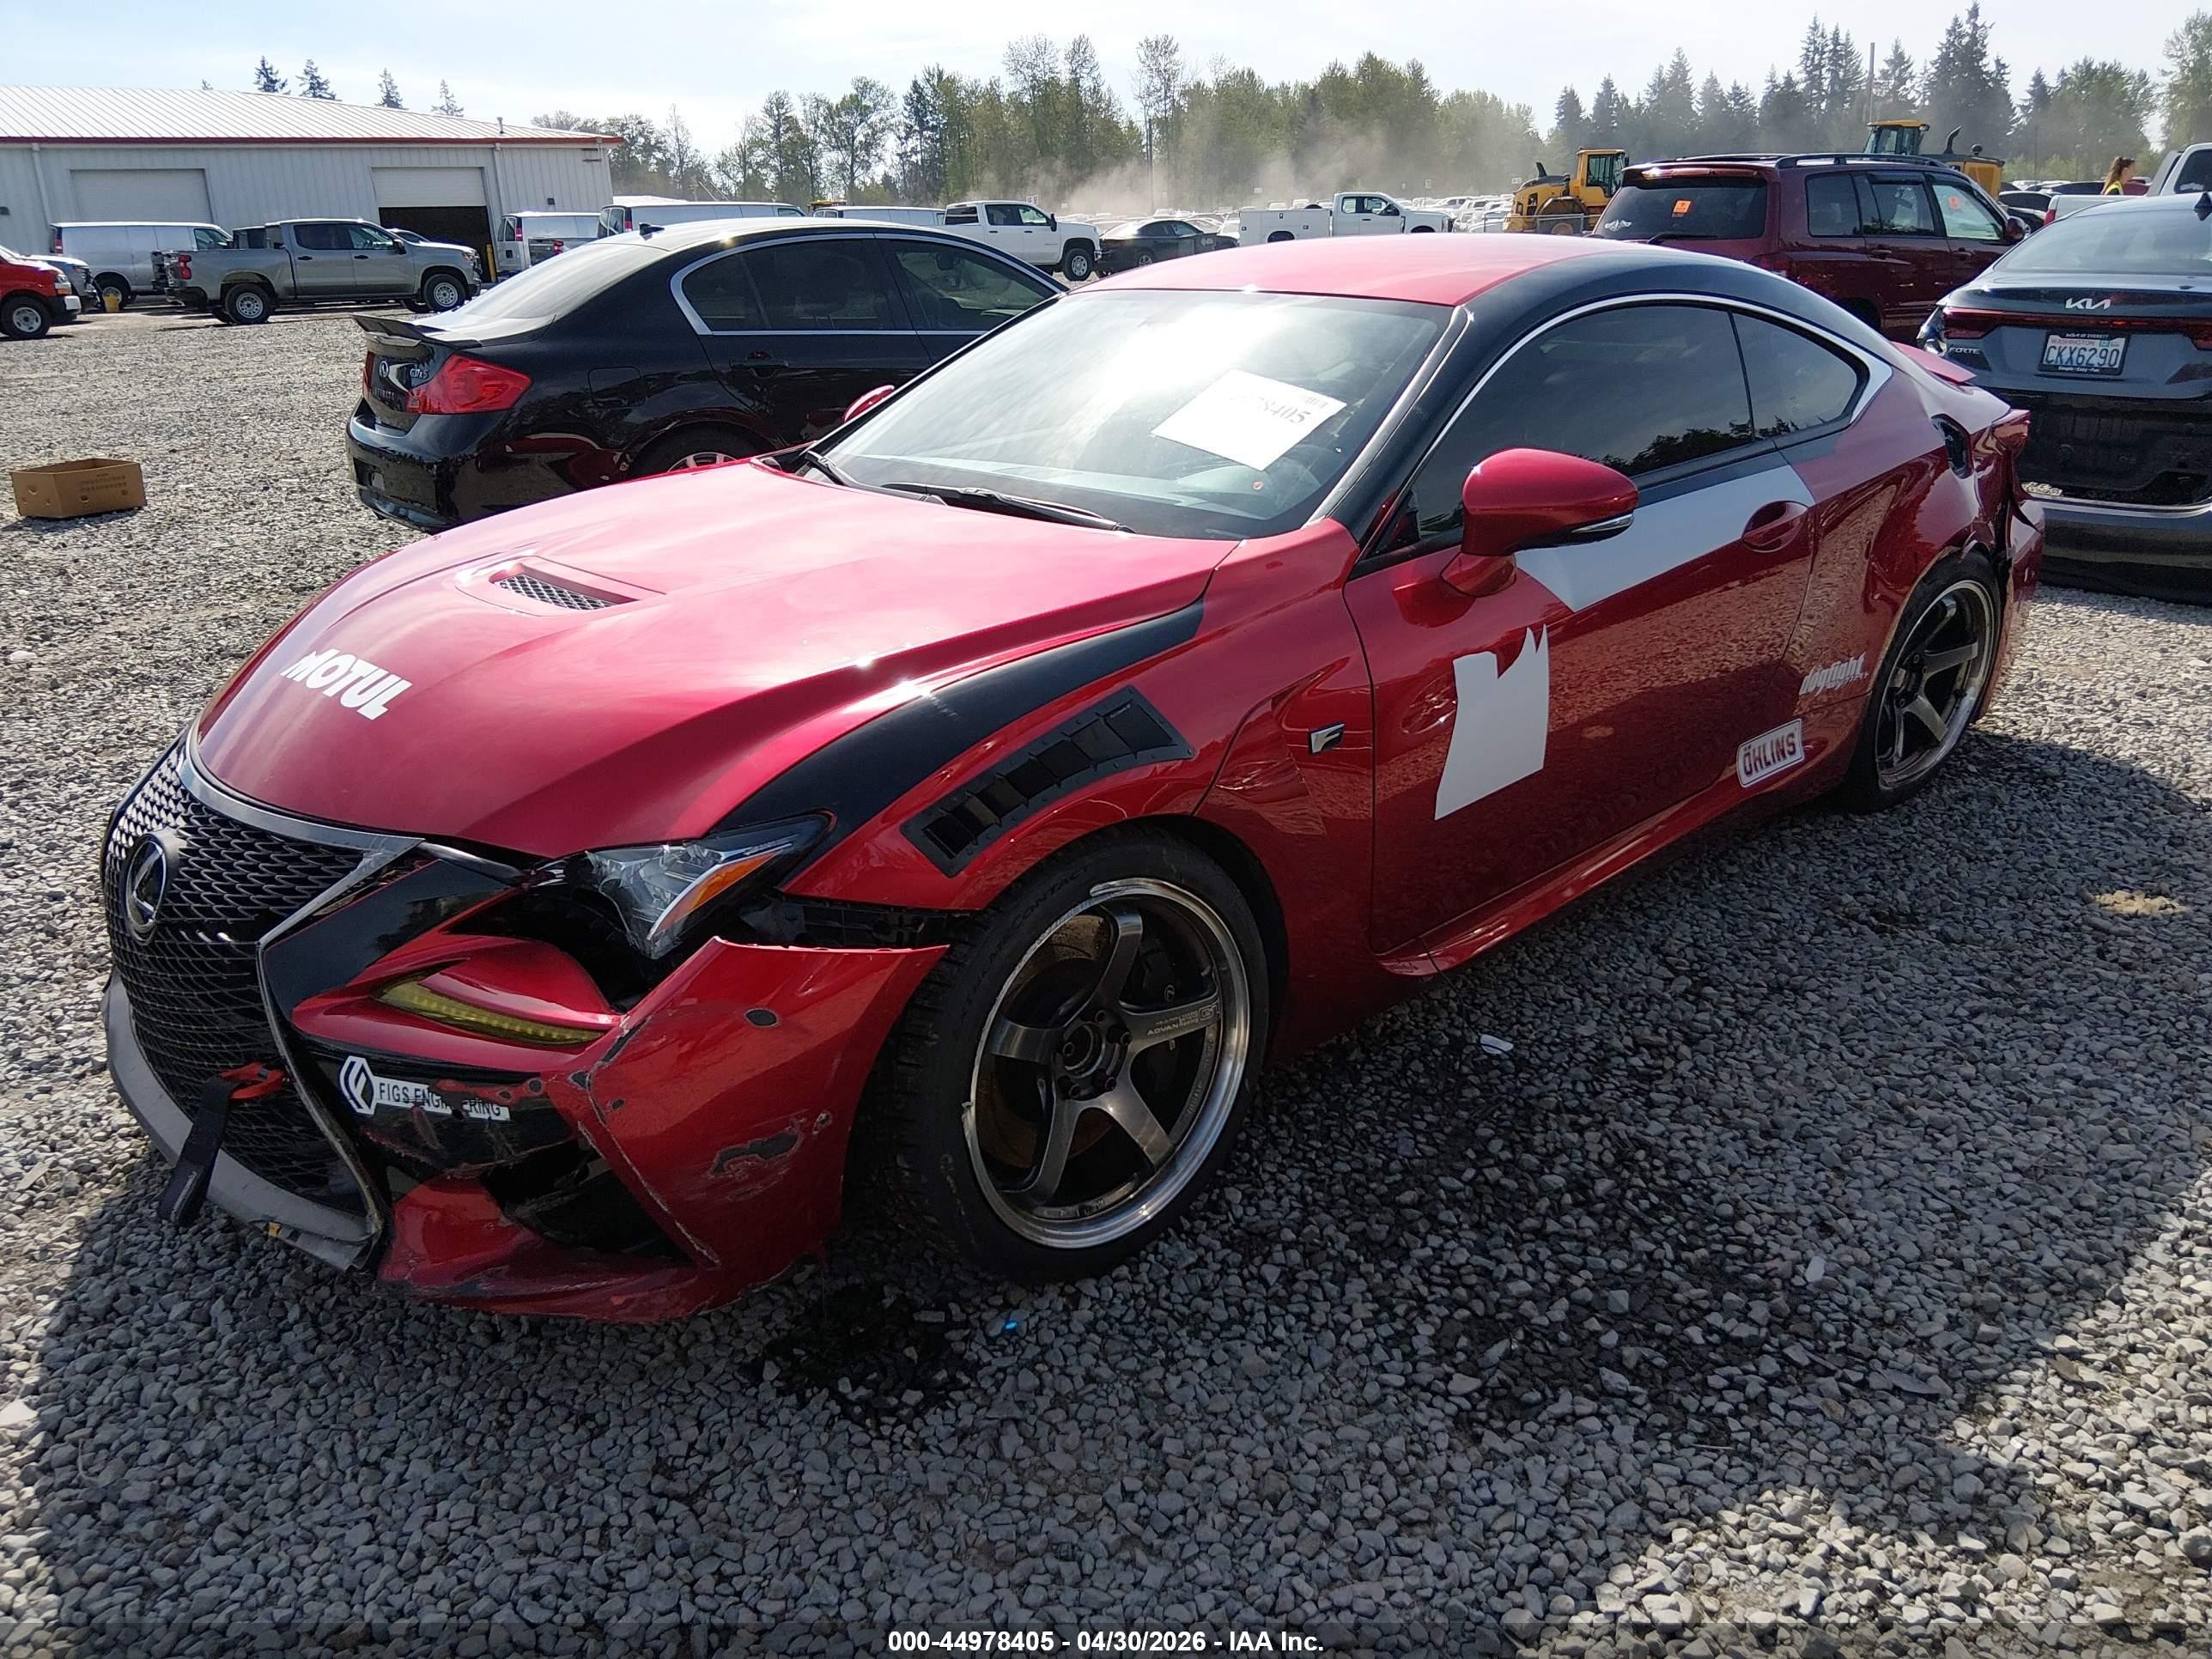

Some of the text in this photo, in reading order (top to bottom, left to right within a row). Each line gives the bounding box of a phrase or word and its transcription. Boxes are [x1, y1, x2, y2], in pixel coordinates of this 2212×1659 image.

[2045, 345, 2120, 368] CKX6290
[280, 648, 413, 720] MOTUL
[1743, 732, 1796, 776] ÖHLINS
[1146, 1023, 1179, 1036] ADVAN
[379, 1083, 410, 1104] FIGS
